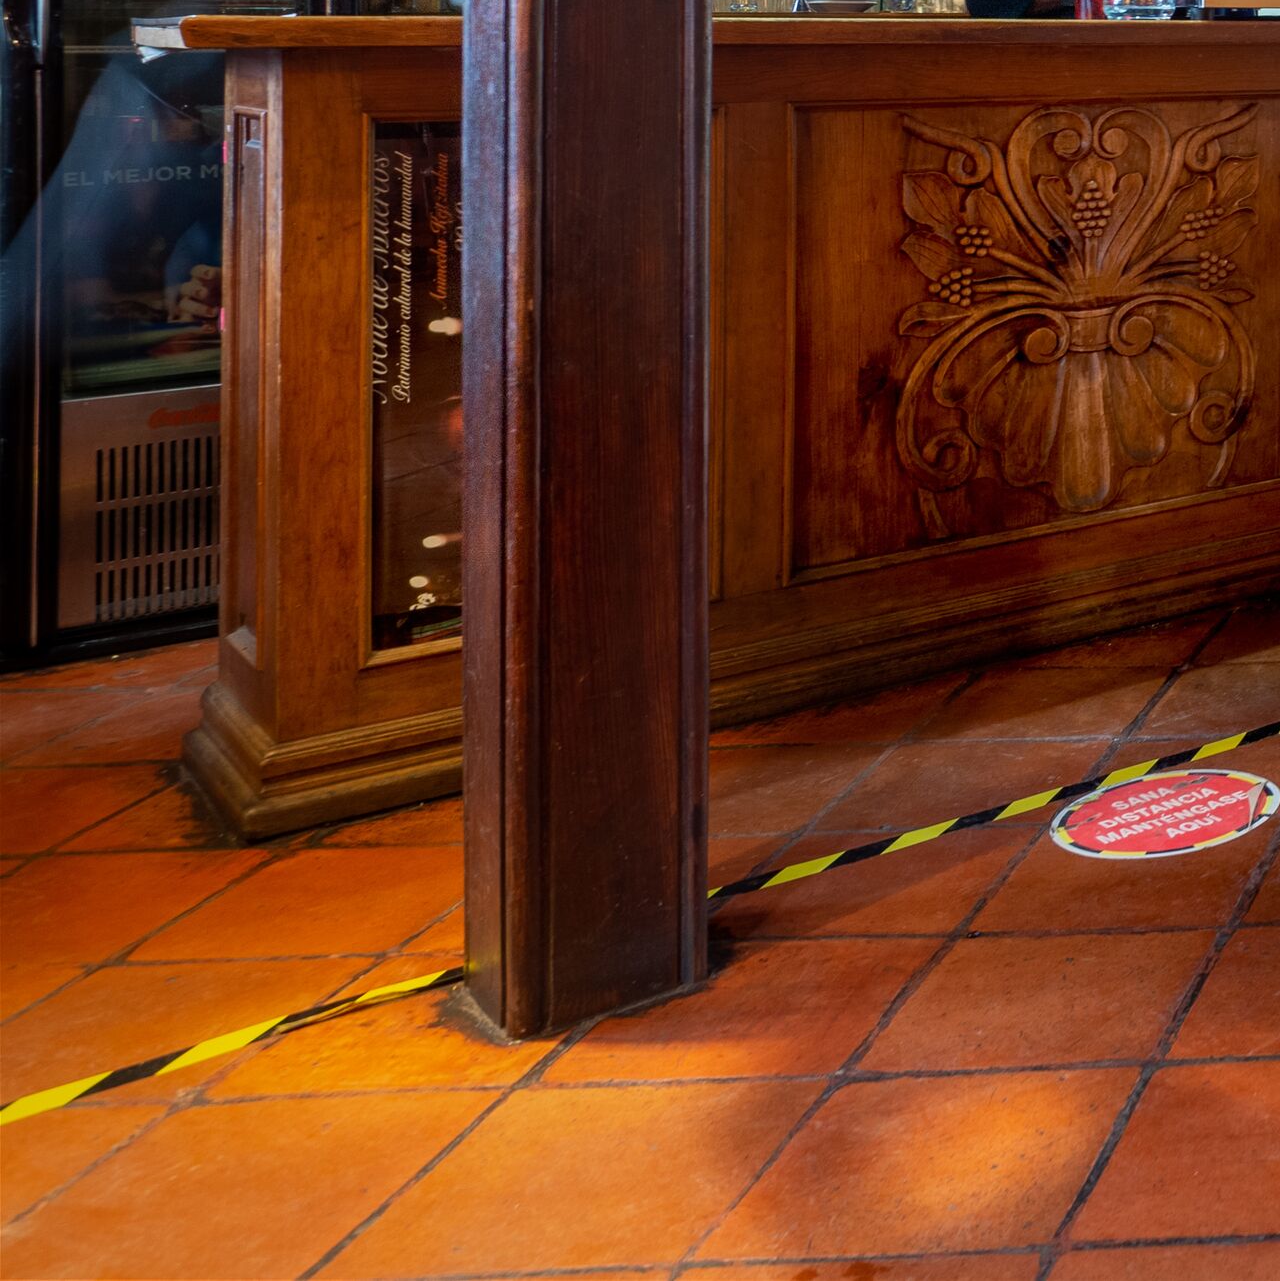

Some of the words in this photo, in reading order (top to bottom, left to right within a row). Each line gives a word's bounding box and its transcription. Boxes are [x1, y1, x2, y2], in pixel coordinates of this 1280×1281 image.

[64, 171, 94, 187] EL
[104, 166, 192, 184] MEJOR
[200, 164, 223, 179] M
[393, 151, 412, 230] humanidad
[393, 233, 412, 246] la
[393, 248, 412, 266] de
[393, 266, 412, 320] cultural
[392, 324, 411, 404] Patrimonio
[1098, 787, 1219, 828] DISTANCIA
[1112, 787, 1175, 810] SANA
[1096, 790, 1249, 844] MANTÉNGASE
[1166, 813, 1222, 838] AQUÍ
